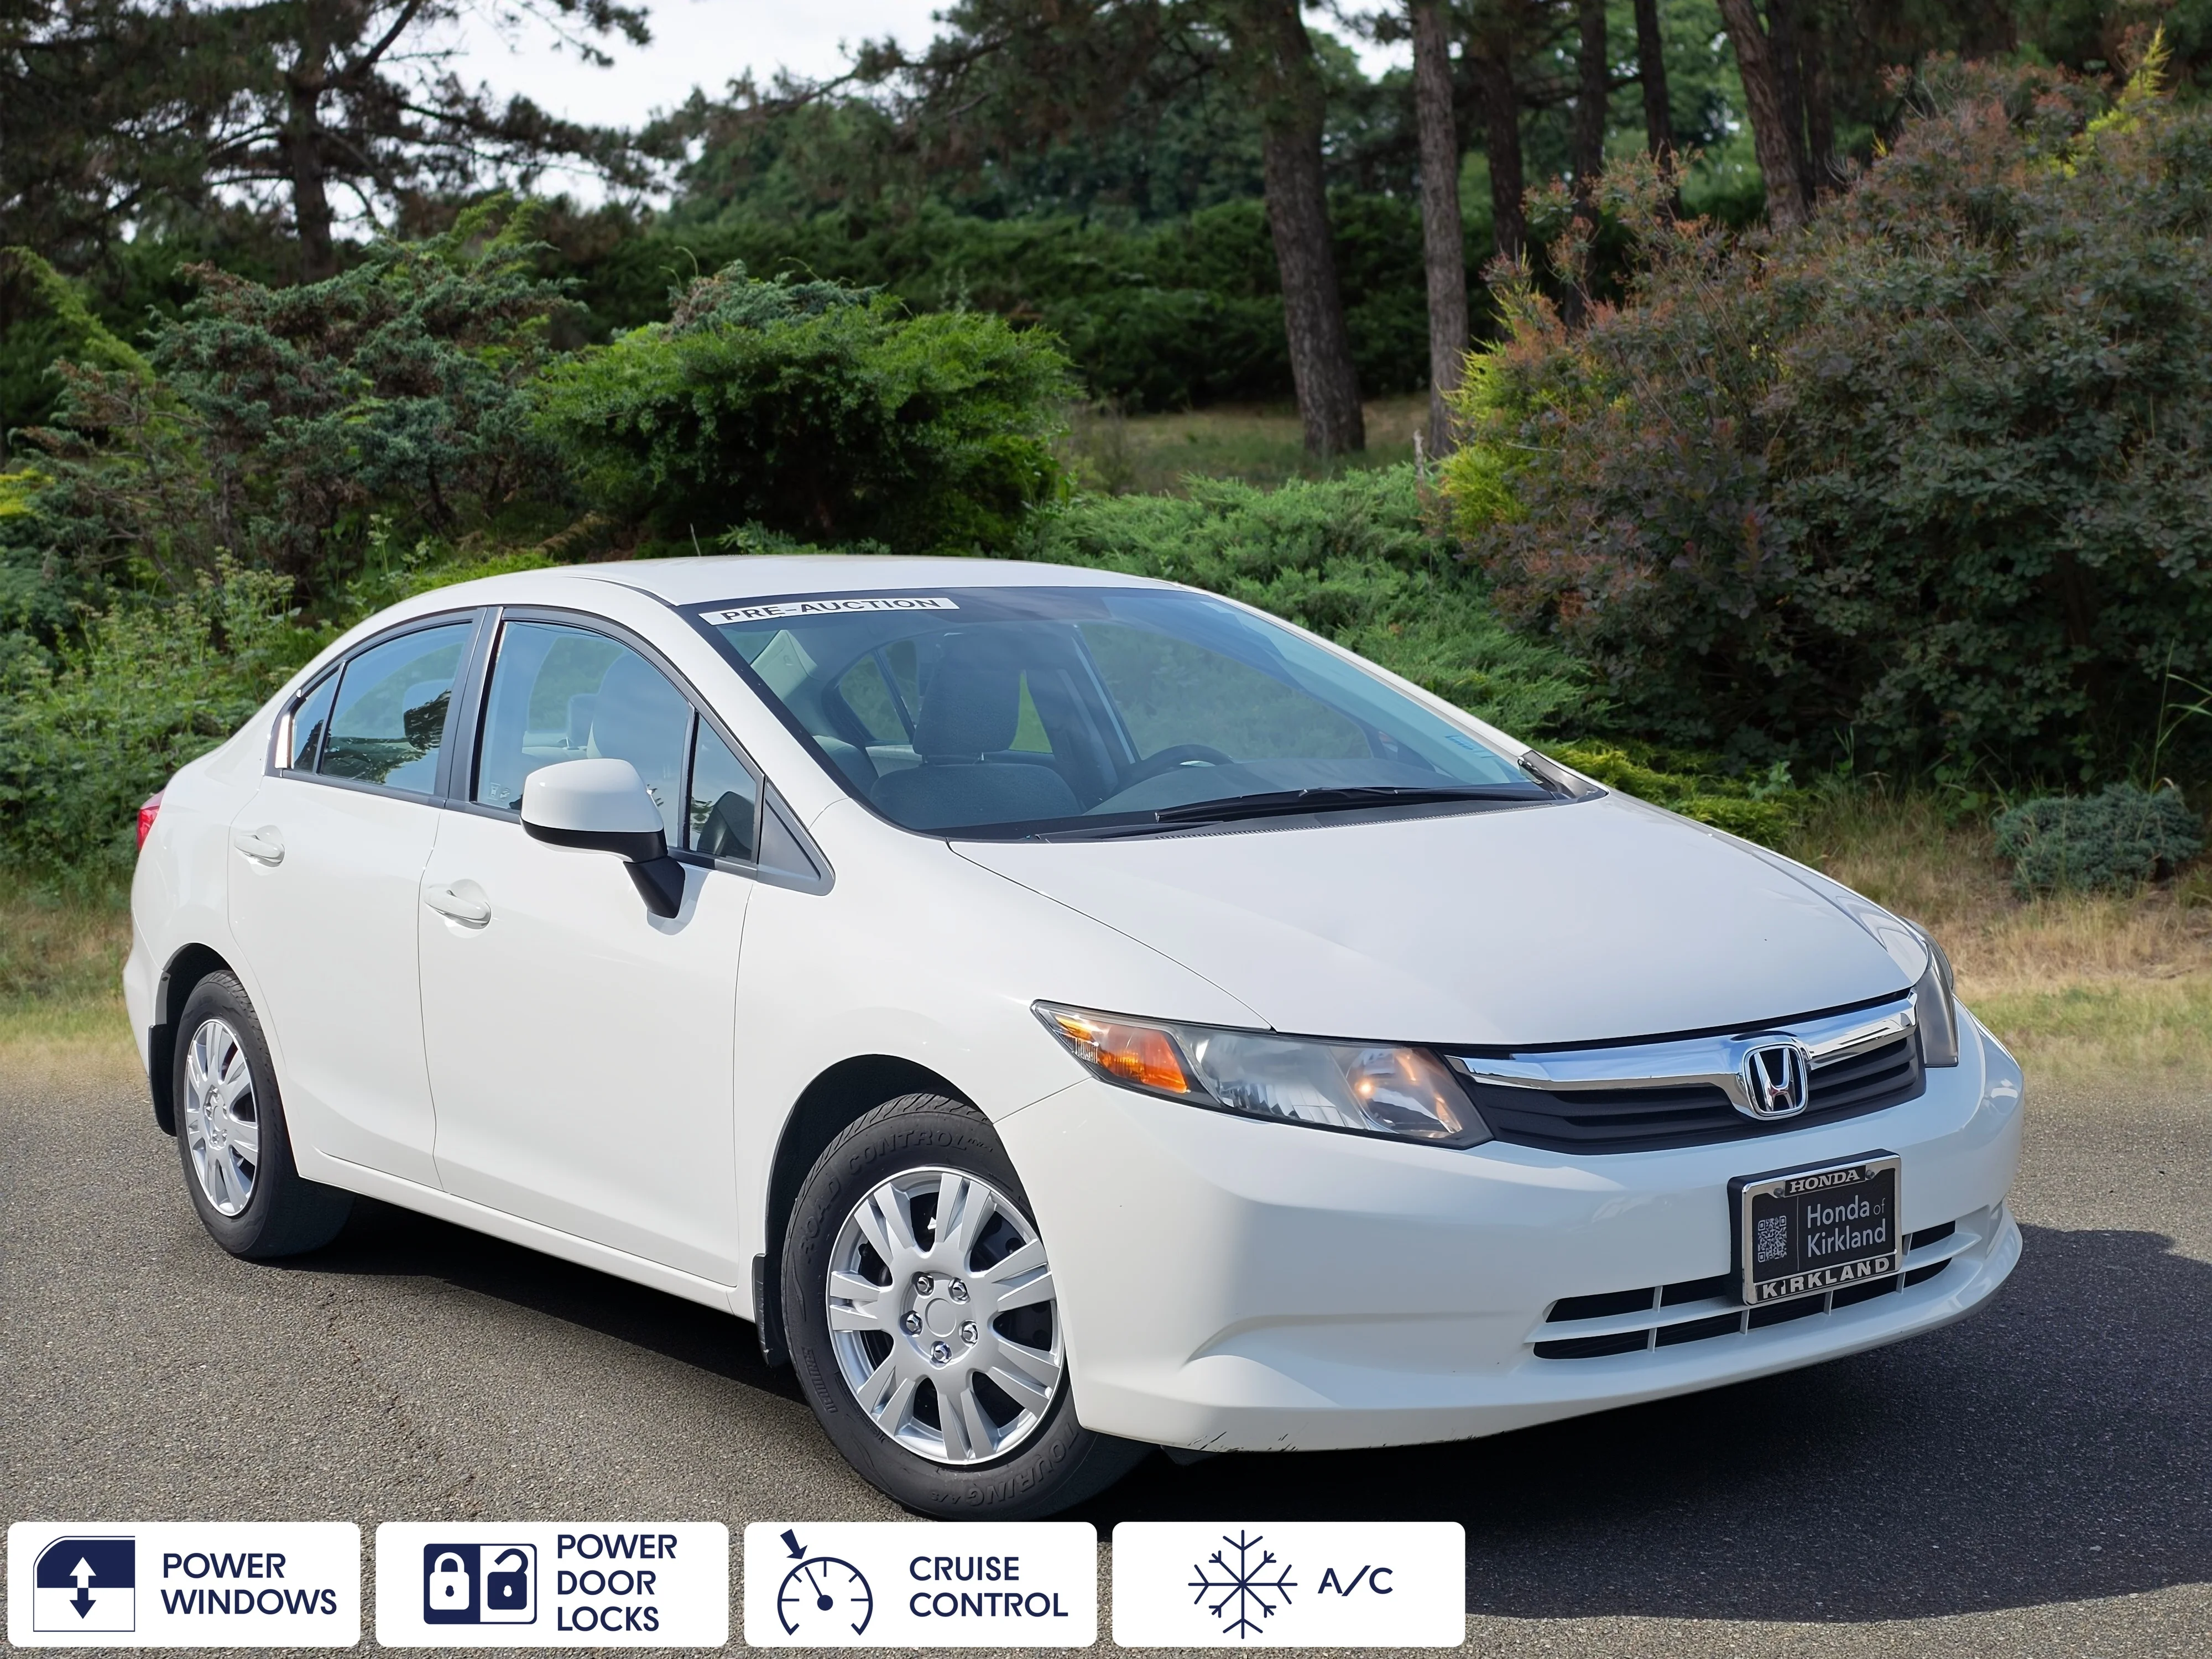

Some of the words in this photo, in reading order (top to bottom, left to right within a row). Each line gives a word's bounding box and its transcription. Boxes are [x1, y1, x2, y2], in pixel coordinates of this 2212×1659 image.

[720, 599, 941, 621] PRE-AUCTION
[801, 1176, 841, 1265] ROAD
[849, 1130, 968, 1176] CONTROL
[1789, 1169, 1860, 1194] HONDA
[1807, 1194, 1870, 1229] Honda
[1873, 1197, 1886, 1215] of
[1807, 1218, 1886, 1258] Kirkland
[1762, 1257, 1890, 1300] KIRKLAND
[967, 1422, 1079, 1507] TOURING
